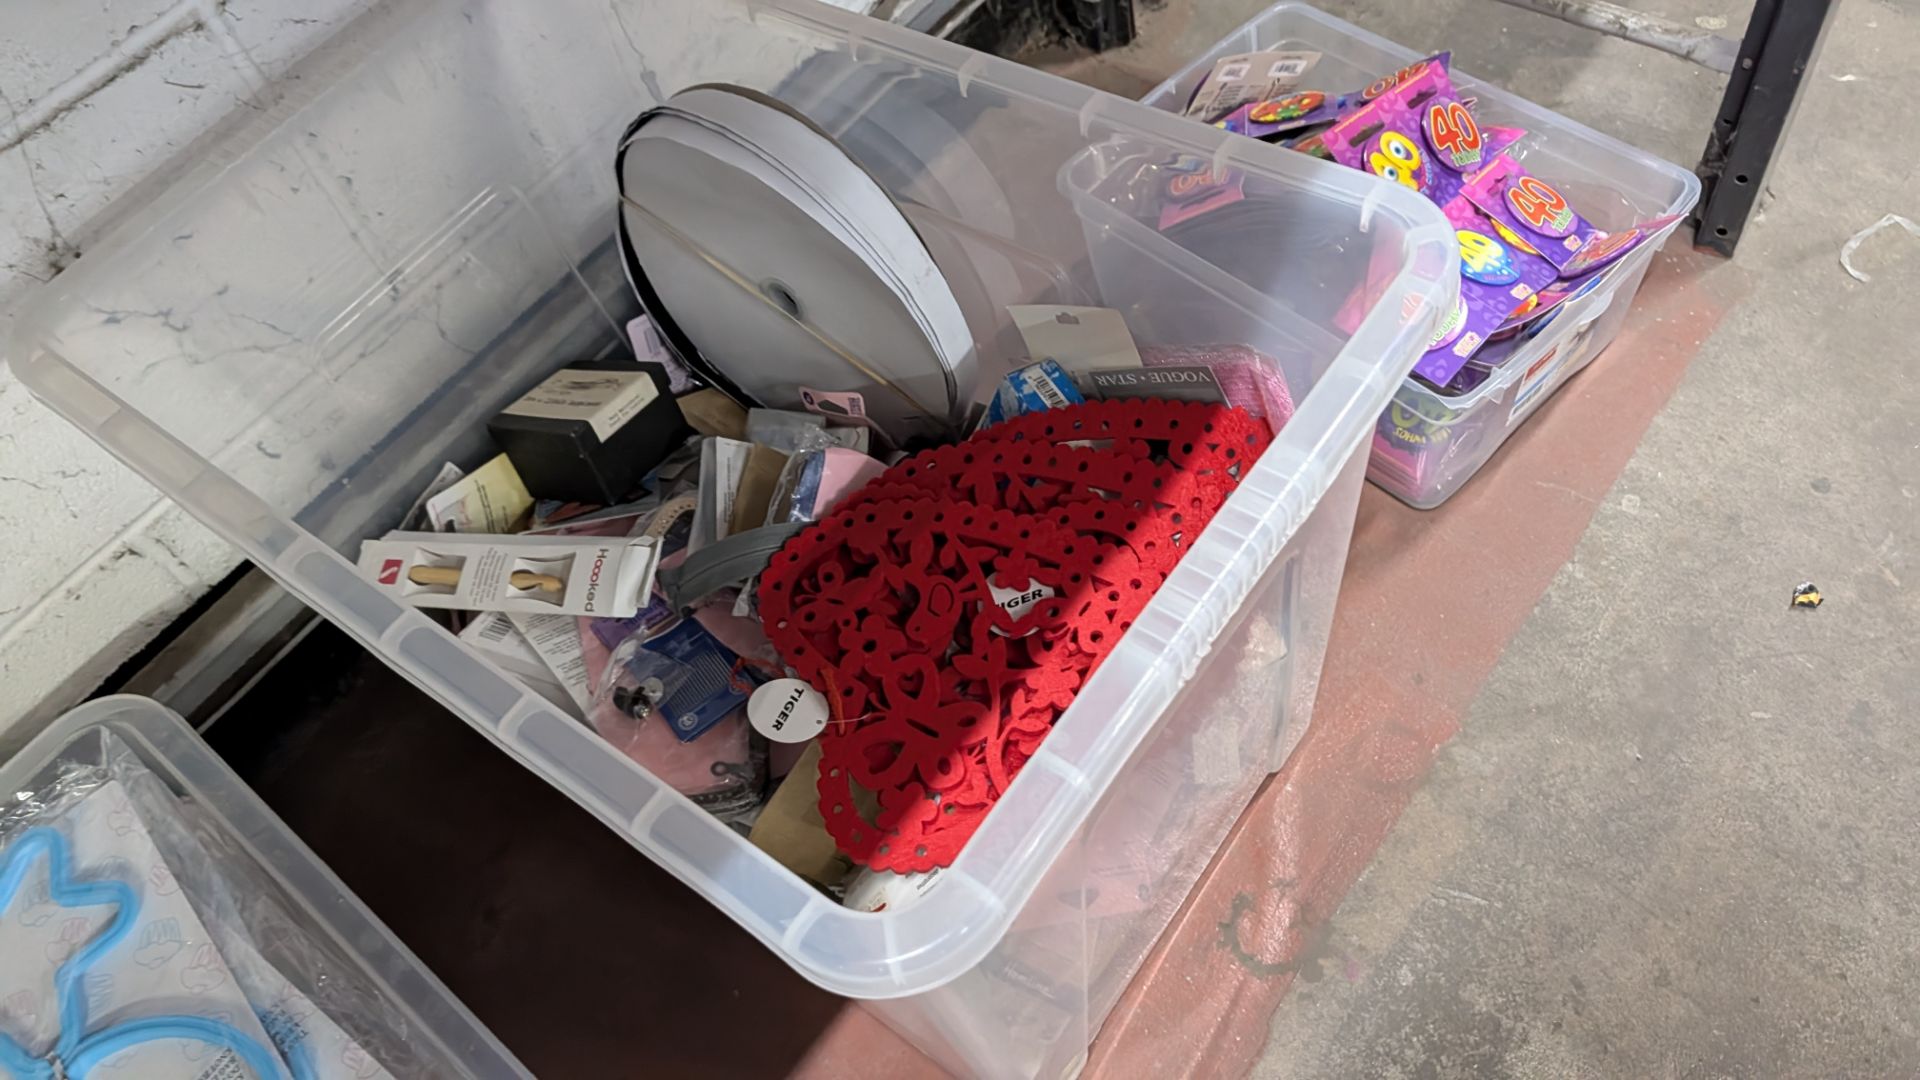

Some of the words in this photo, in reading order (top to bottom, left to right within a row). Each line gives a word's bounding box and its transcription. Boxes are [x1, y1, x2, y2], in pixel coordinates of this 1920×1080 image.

[1430, 102, 1481, 154] 40
[1508, 176, 1568, 227] 40
[1456, 230, 1504, 272] 40
[1095, 373, 1137, 386] STAR
[1151, 371, 1210, 384] VOGUE
[997, 589, 1043, 609] IGER
[772, 688, 805, 731] TIGER
